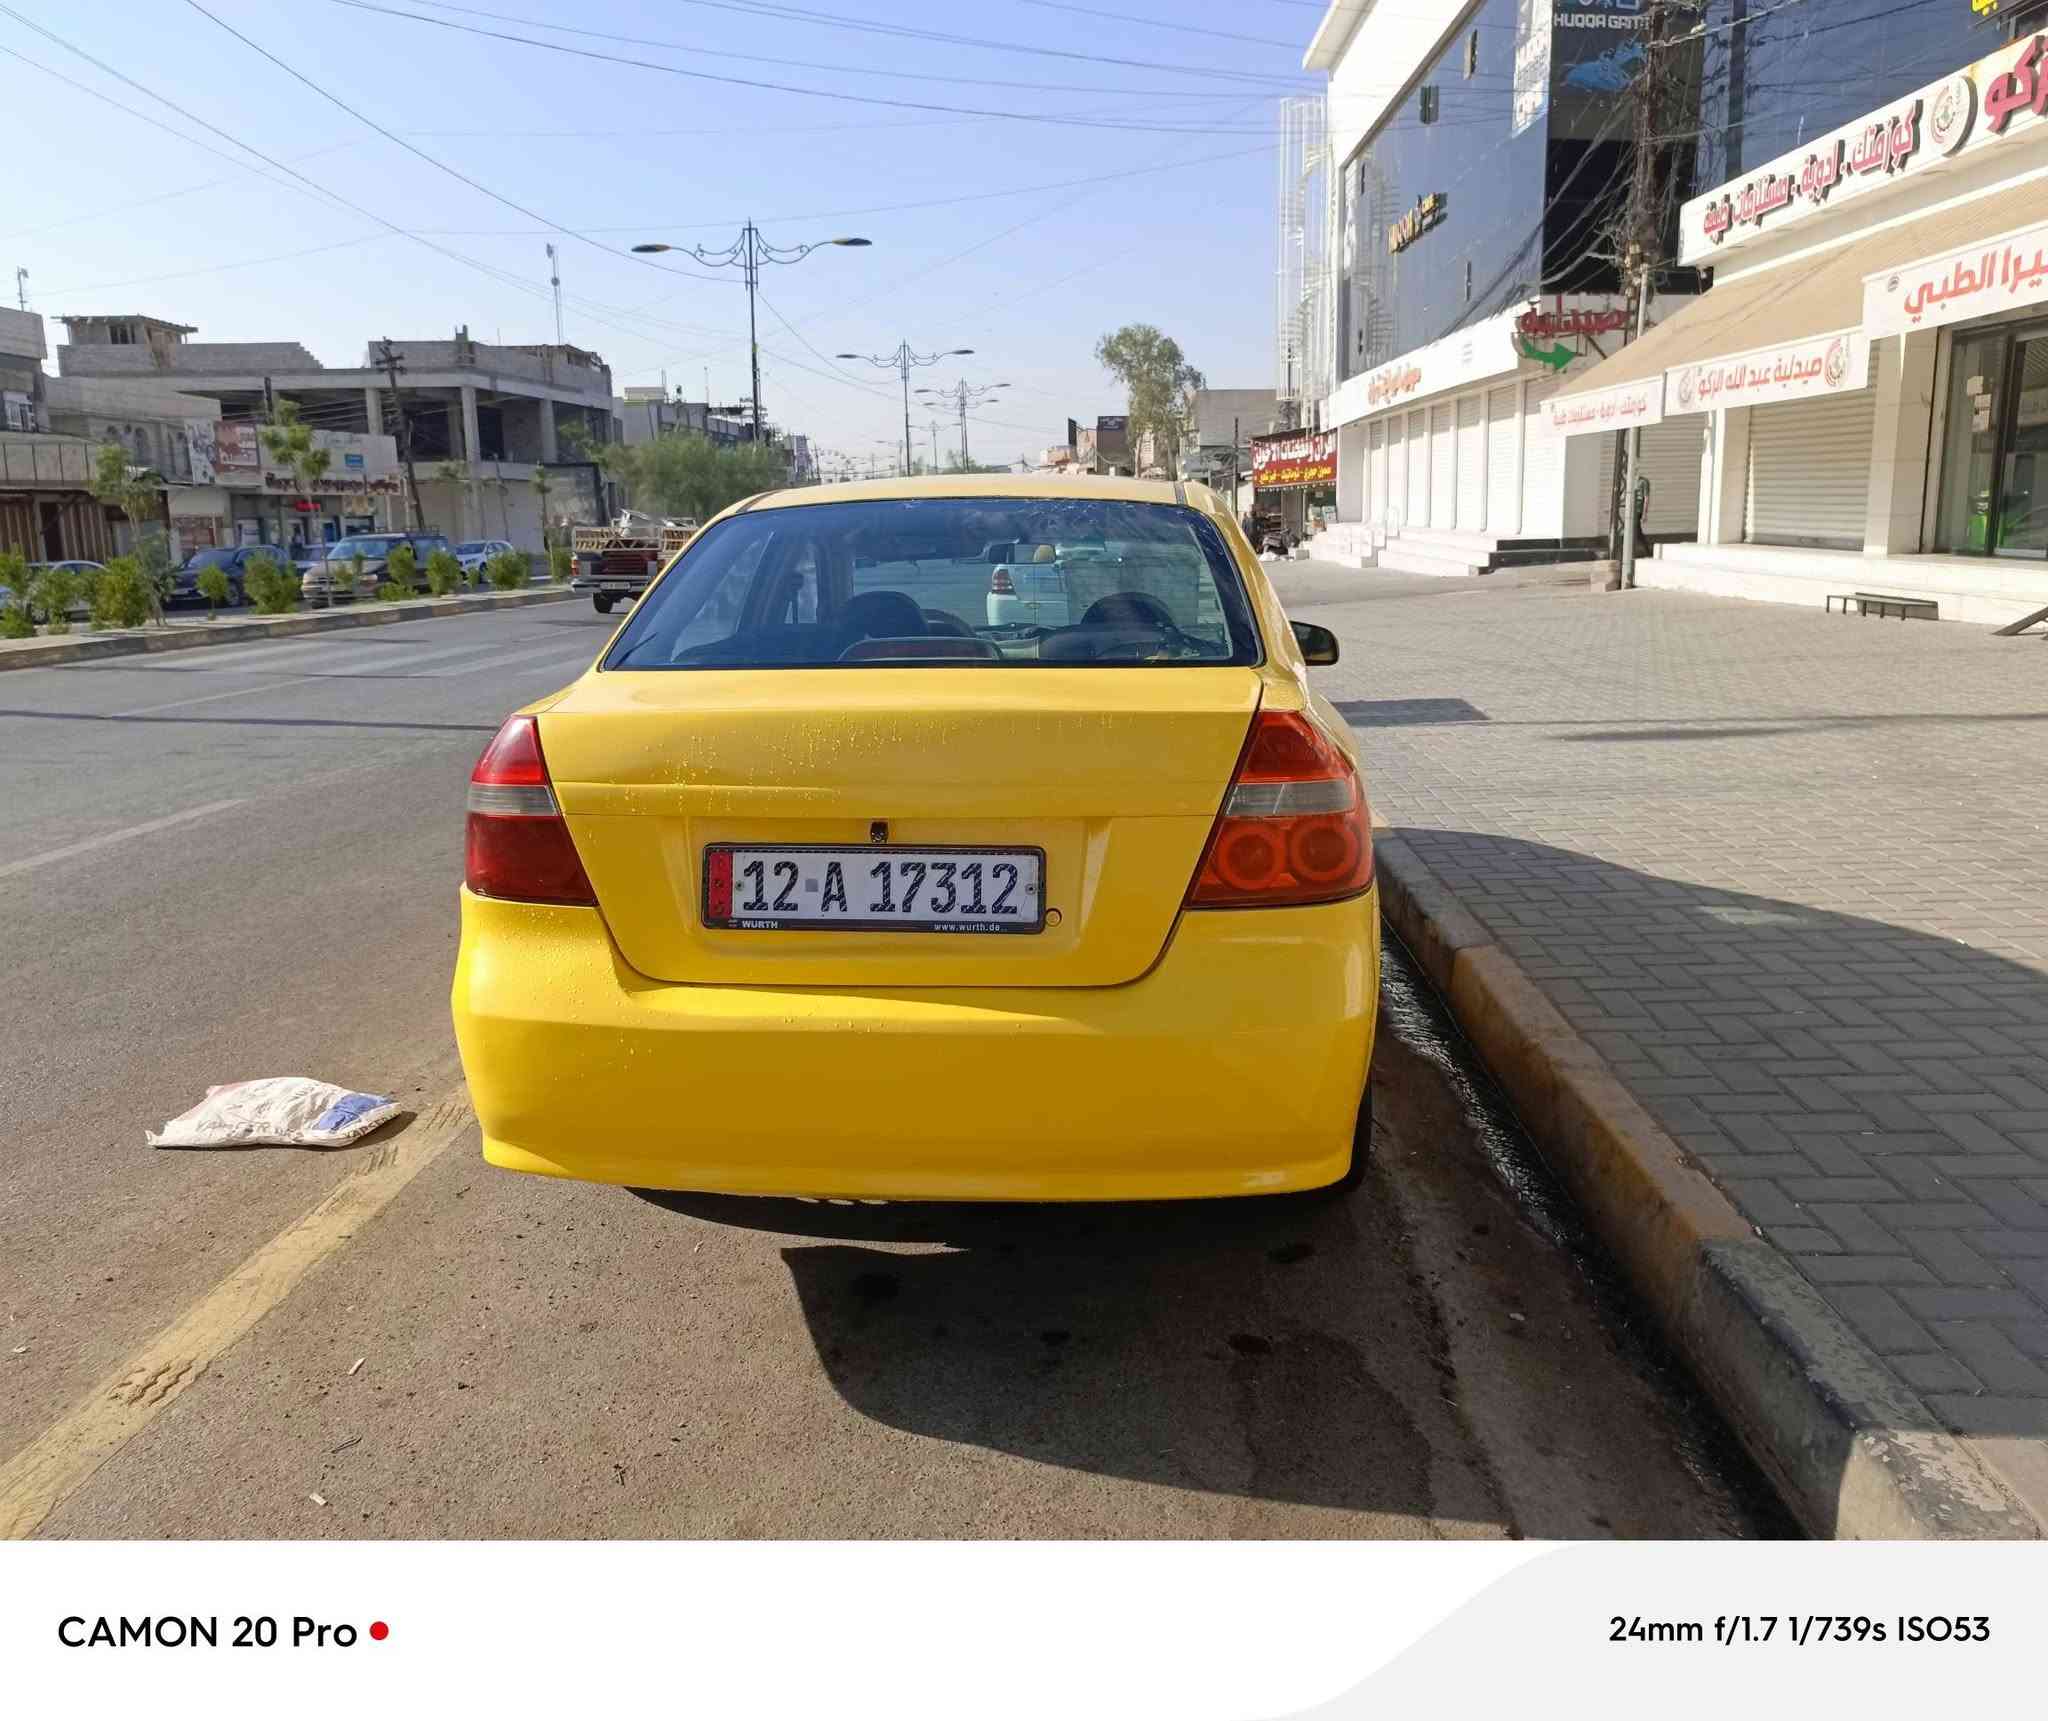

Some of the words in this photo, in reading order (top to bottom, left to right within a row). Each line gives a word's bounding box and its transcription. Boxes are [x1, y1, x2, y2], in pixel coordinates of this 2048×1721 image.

[1904, 250, 1998, 323] الطبي
[1725, 364, 1747, 390] الله
[1748, 367, 1771, 392] عبد
[1774, 354, 1823, 389] صيدلية
[743, 860, 799, 912] 12
[820, 861, 848, 913] A
[870, 861, 1018, 915] 17312
